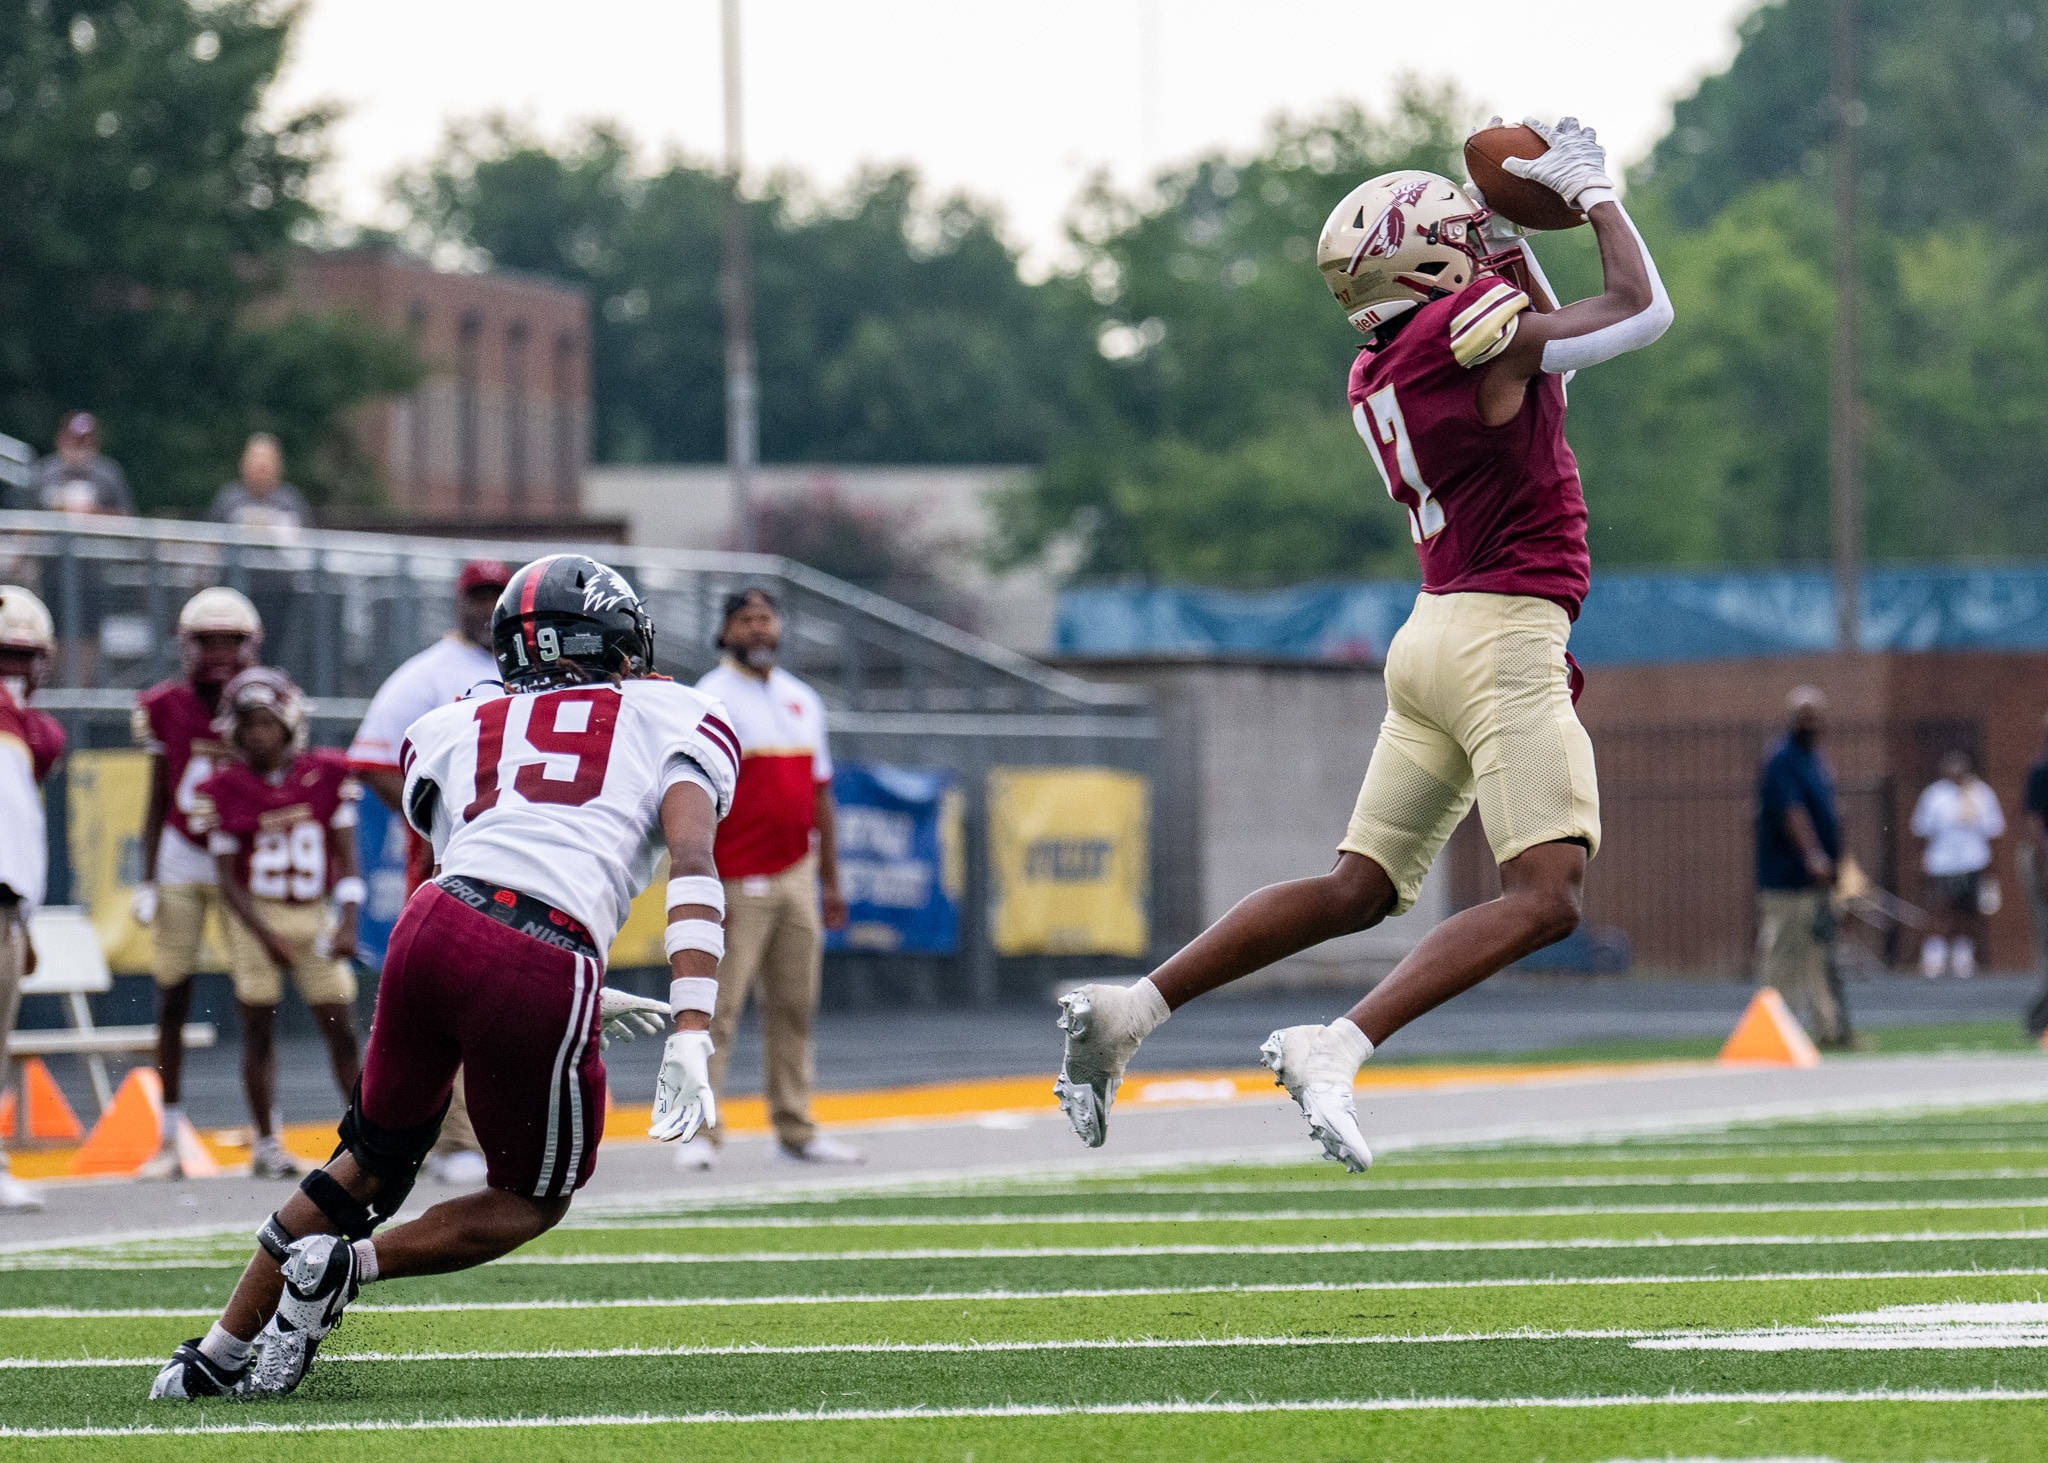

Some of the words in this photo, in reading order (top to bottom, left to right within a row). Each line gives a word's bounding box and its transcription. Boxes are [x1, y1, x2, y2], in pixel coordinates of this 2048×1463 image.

[1352, 382, 1447, 544] 17
[512, 627, 561, 667] 19
[462, 687, 624, 824] 19
[250, 820, 327, 899] 29
[442, 879, 487, 908] PRO
[520, 921, 577, 950] NIKE
